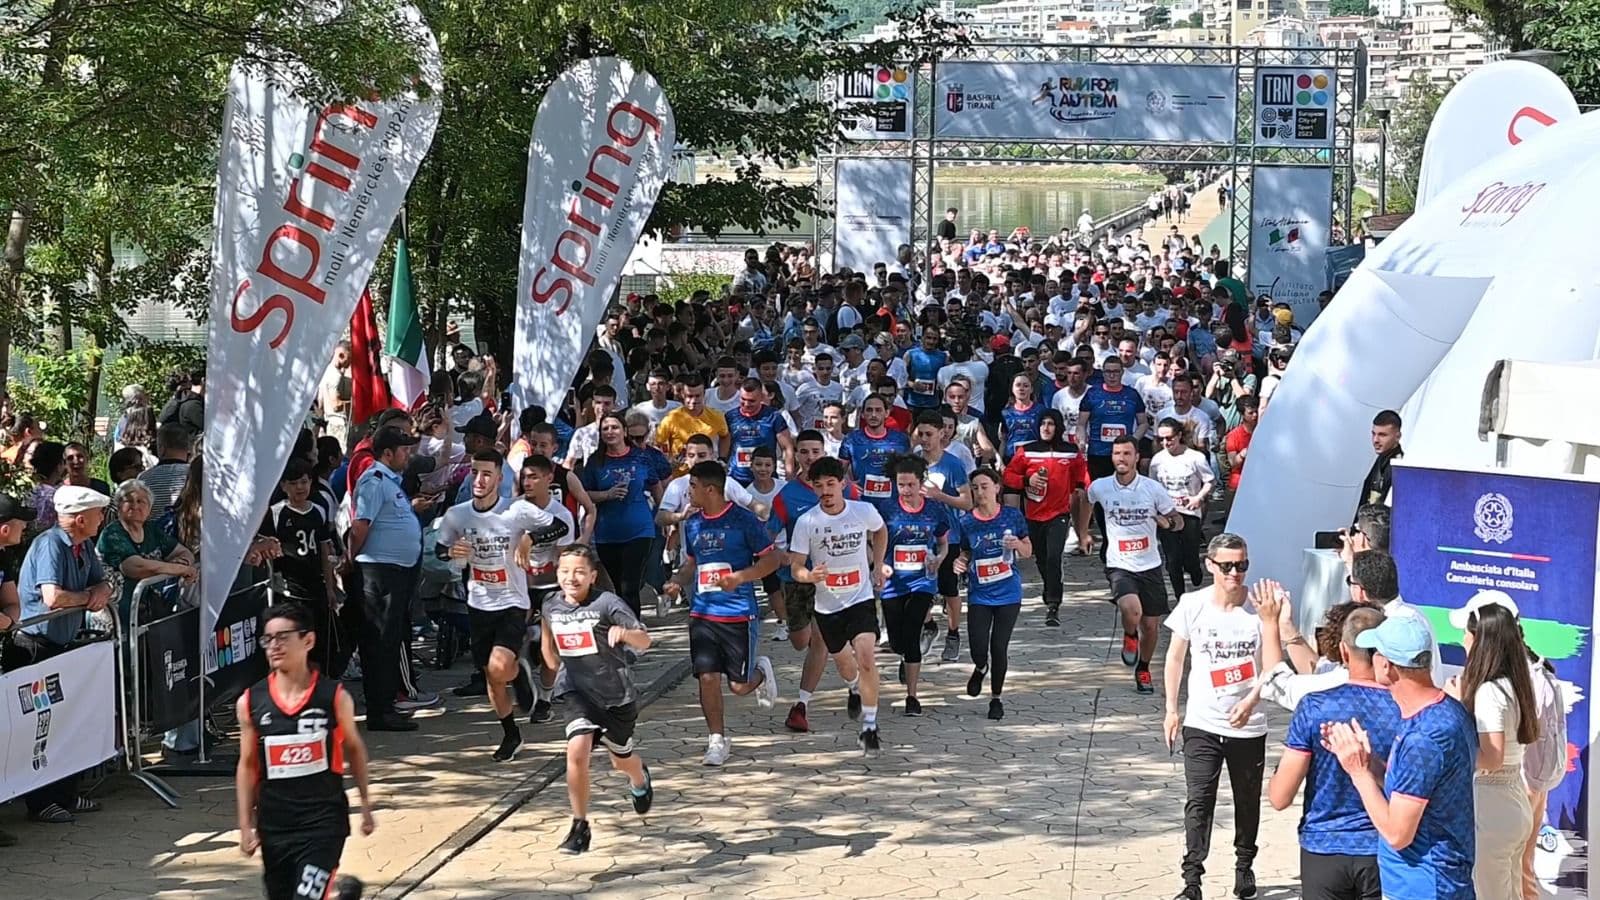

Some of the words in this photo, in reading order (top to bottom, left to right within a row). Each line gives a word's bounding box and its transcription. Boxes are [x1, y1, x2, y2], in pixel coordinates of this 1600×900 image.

[1265, 76, 1291, 103] TRN
[873, 482, 886, 493] 57
[296, 529, 318, 556] 34
[1126, 541, 1143, 550] 320
[904, 553, 917, 562] 30
[987, 565, 1000, 575] 59
[1450, 560, 1502, 575] Ambasciata
[1504, 566, 1536, 579] d'Italia
[707, 572, 720, 584] 29
[835, 576, 849, 585] 41
[1446, 572, 1494, 586] Cancelleria
[1496, 580, 1539, 591] consolare
[1225, 669, 1242, 683] 88
[280, 747, 313, 764] 428
[297, 864, 330, 899] 55
